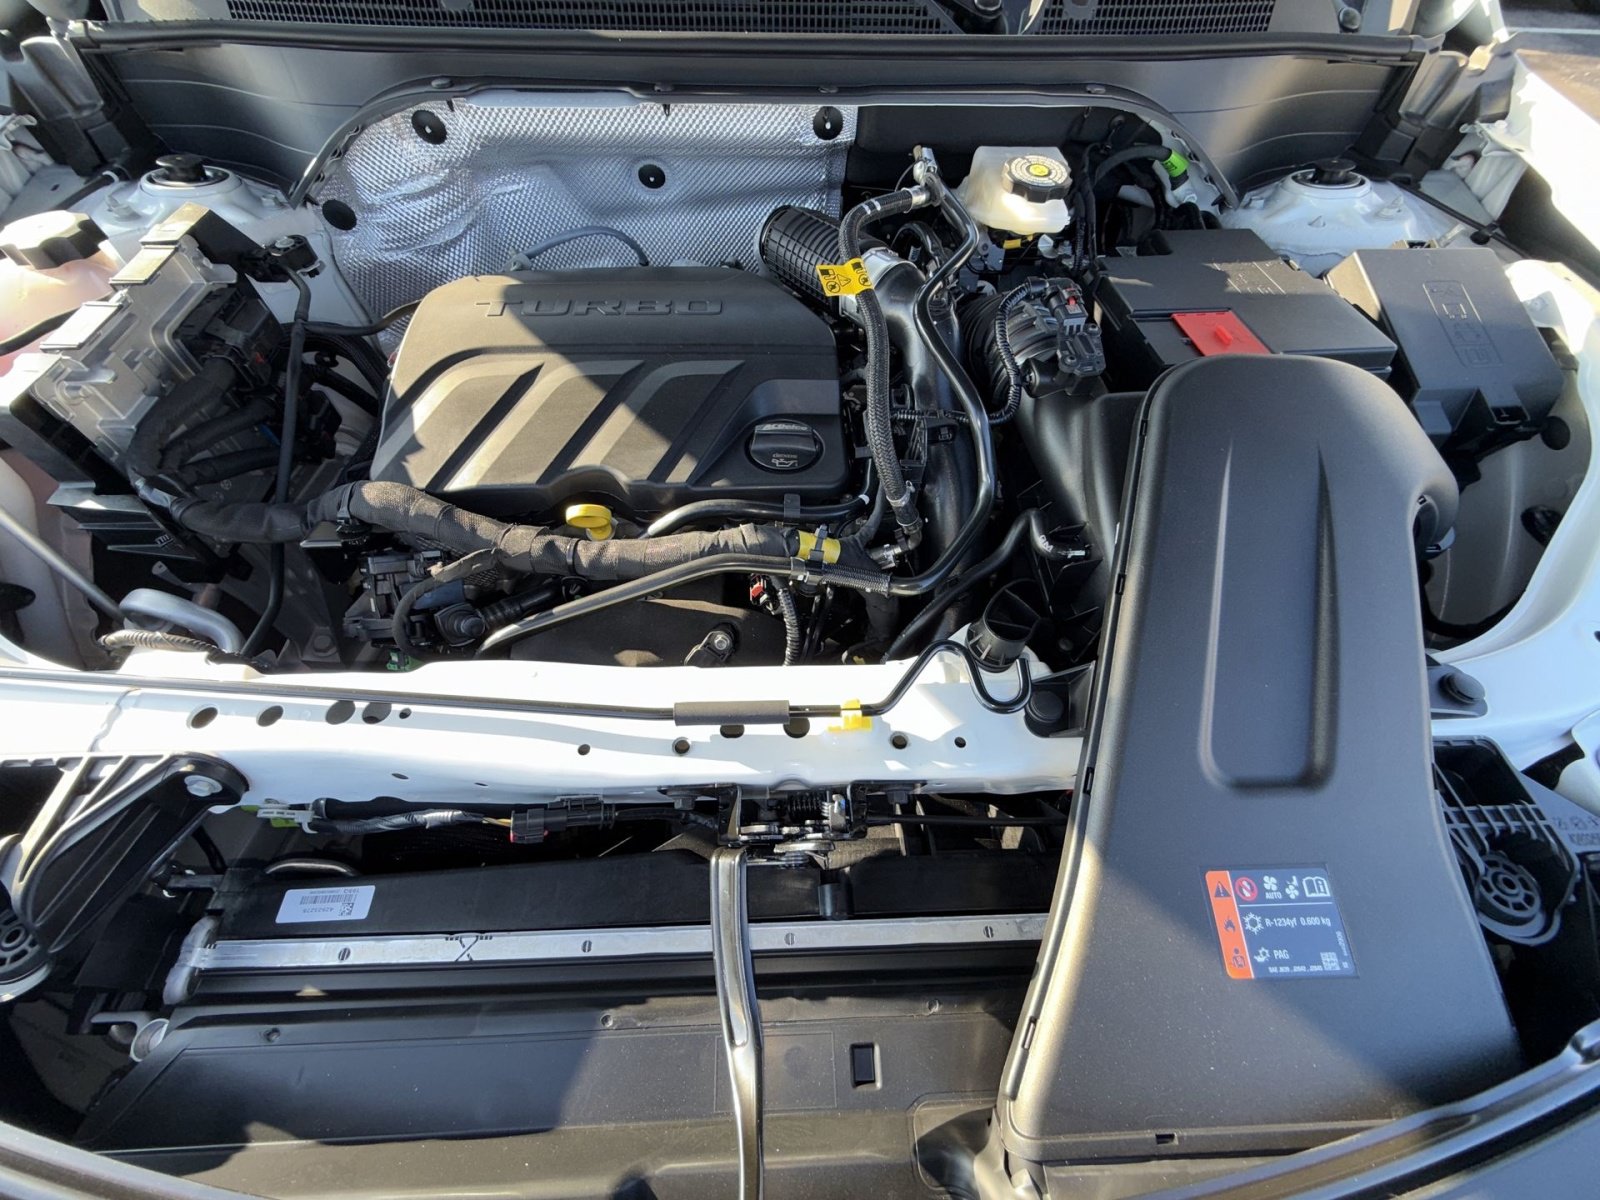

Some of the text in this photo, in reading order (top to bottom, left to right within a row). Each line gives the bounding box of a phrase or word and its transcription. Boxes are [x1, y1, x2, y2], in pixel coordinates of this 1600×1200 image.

[475, 300, 723, 317] TURBO
[1265, 916, 1331, 928] R-1234yf 0.600 kg
[1273, 950, 1290, 960] PAG
